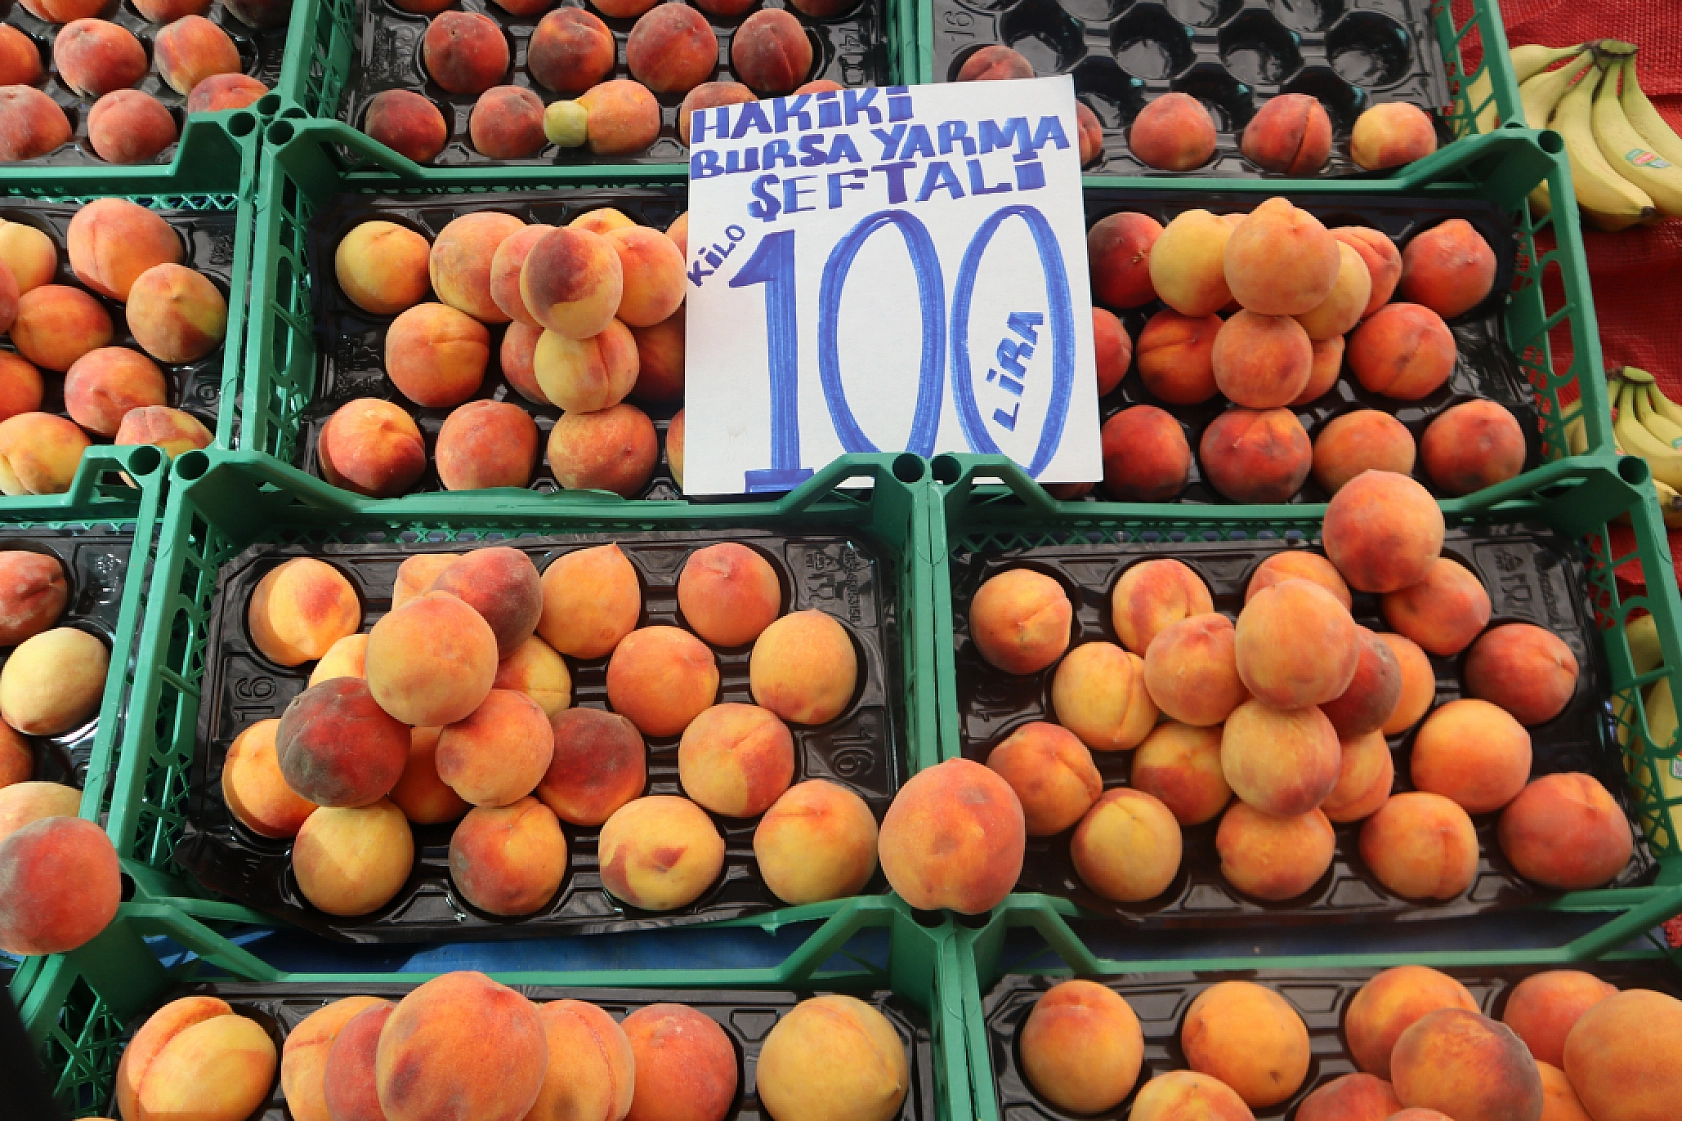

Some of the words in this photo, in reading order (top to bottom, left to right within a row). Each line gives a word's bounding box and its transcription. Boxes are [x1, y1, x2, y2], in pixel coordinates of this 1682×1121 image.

[690, 133, 863, 181] BURSA
[870, 116, 1071, 162] YARMA
[728, 204, 1076, 494] 100
[233, 676, 276, 722] 16
